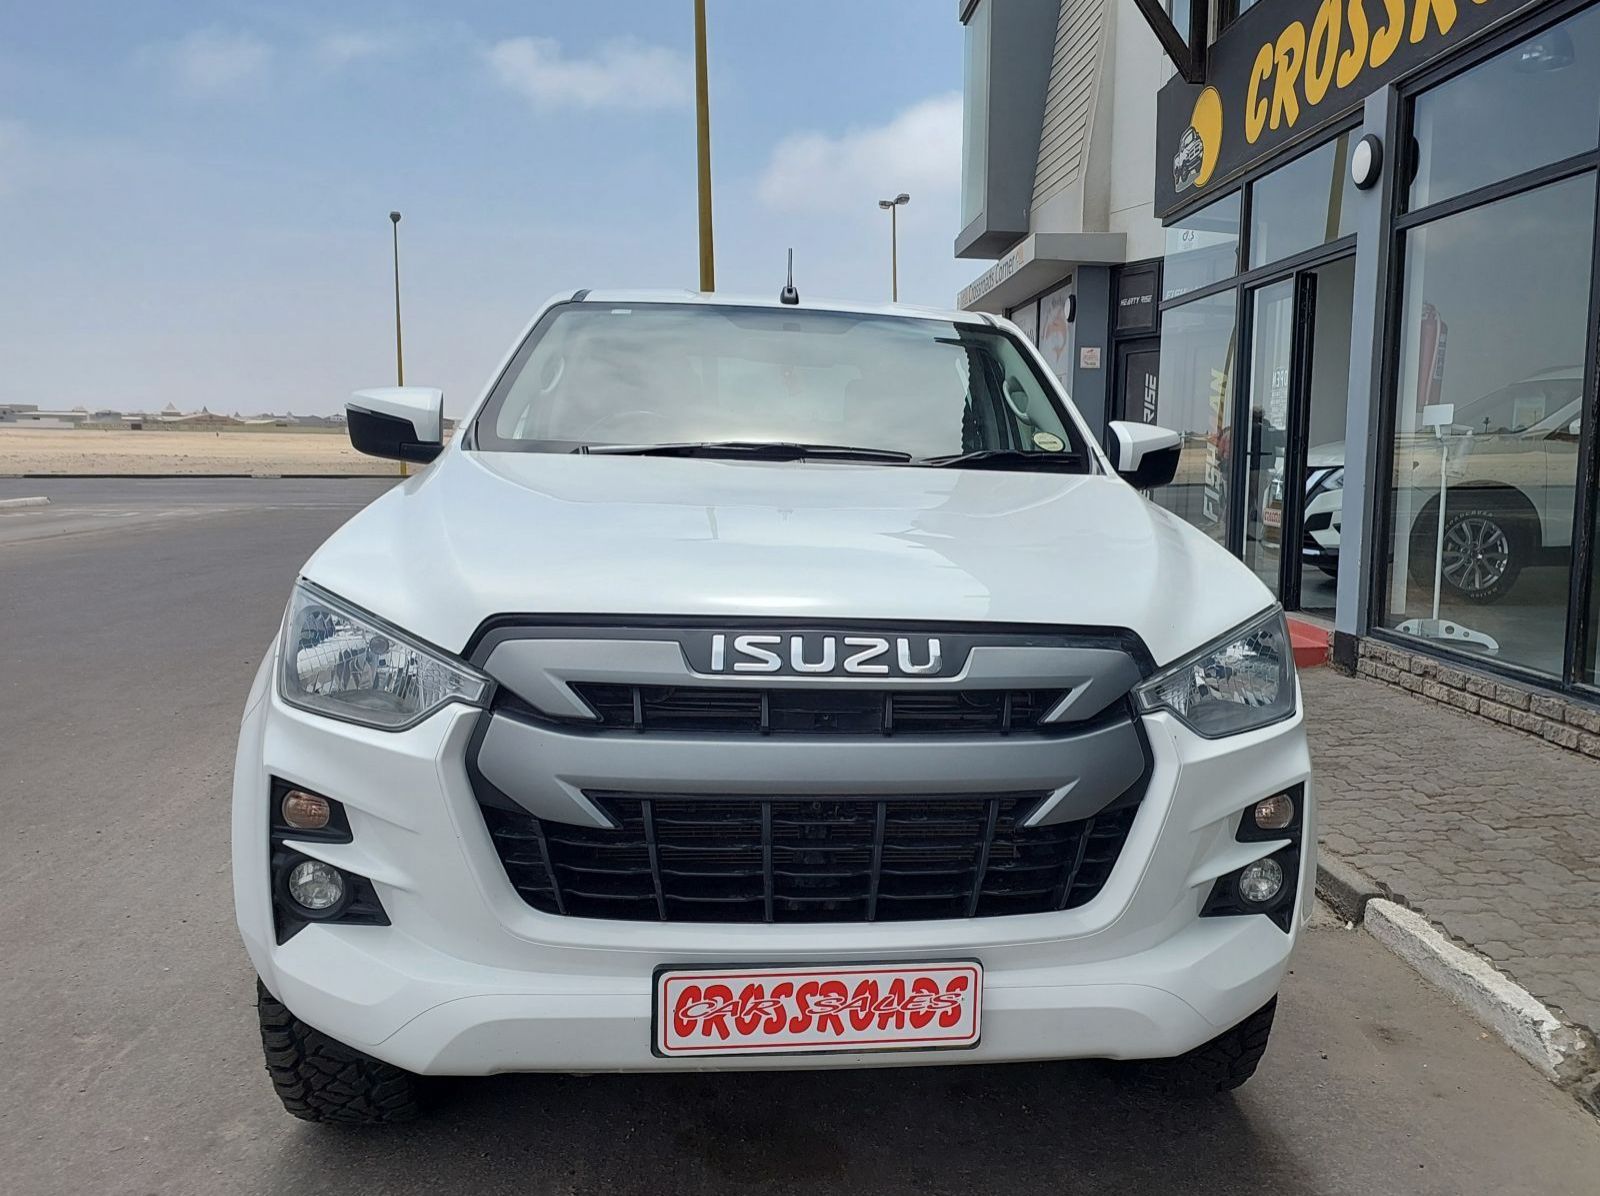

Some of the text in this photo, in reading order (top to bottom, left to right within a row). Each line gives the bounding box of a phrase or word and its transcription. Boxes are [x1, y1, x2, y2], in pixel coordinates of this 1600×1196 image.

[1245, 0, 1488, 144] CROSS
[1143, 373, 1157, 423] RISE
[1203, 368, 1226, 523] FISHAN
[710, 634, 943, 674] ISUZU
[673, 976, 969, 1041] CROSSROADS
[680, 992, 962, 1020] CAR SALES
